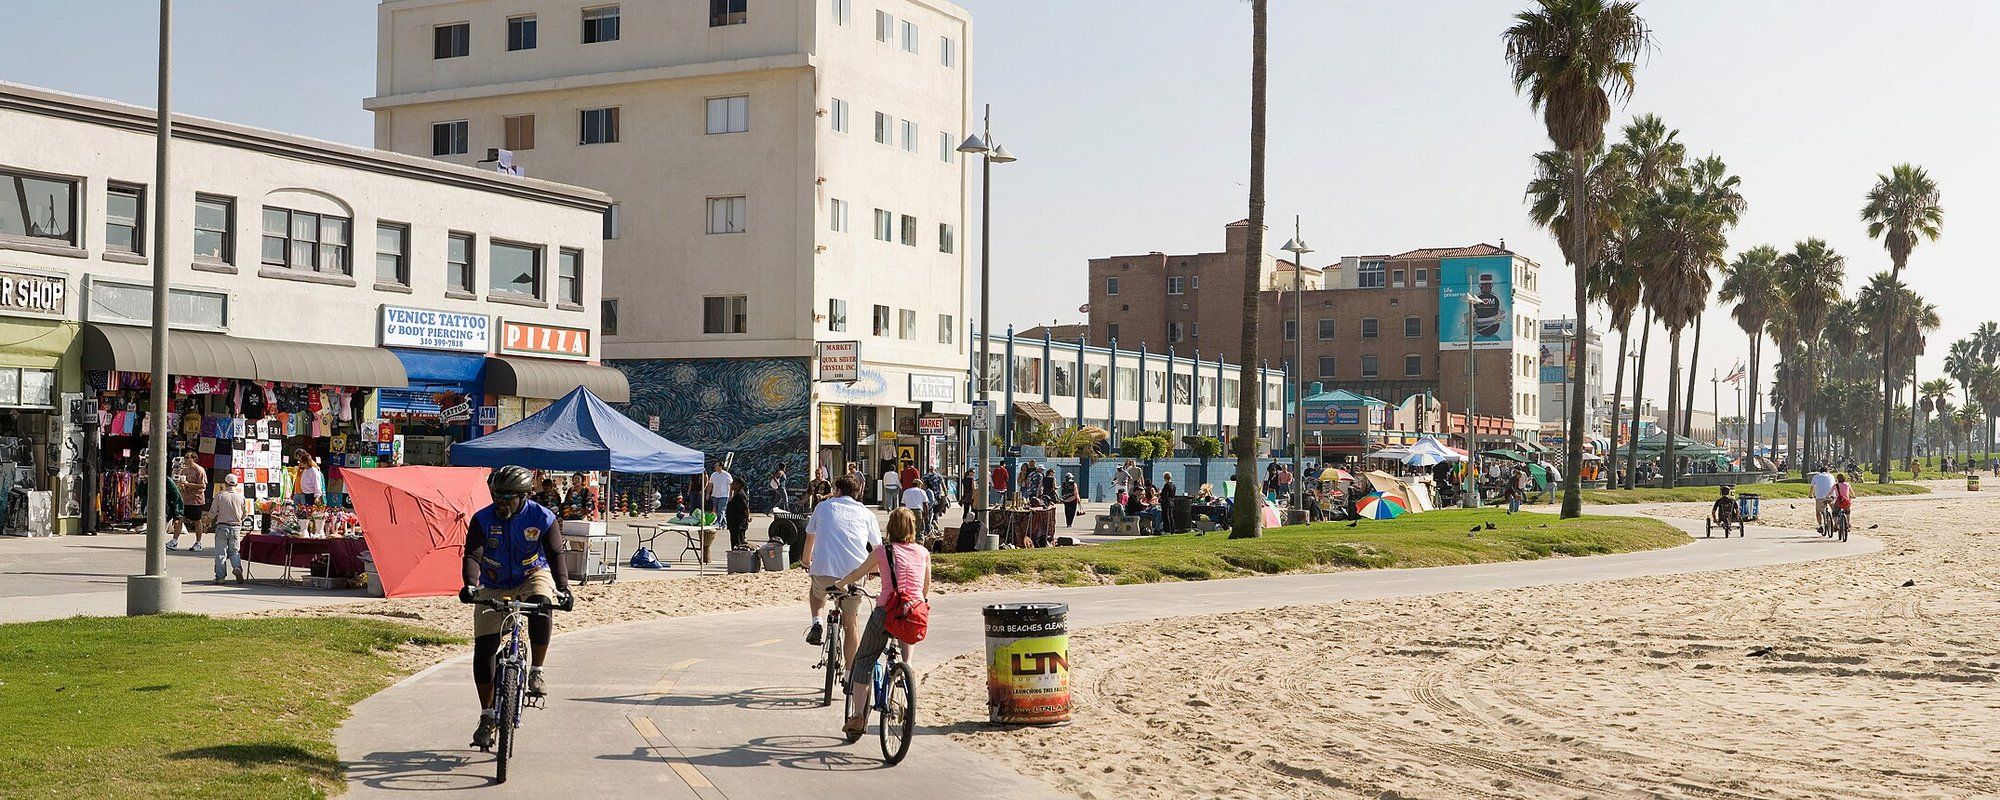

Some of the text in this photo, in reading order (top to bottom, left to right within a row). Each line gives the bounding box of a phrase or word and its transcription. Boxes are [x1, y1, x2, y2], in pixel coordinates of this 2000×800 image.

[16, 278, 64, 310] SHOP
[388, 309, 486, 329] VENICE TATTOO
[387, 324, 397, 334] &
[398, 325, 425, 336] BODY
[427, 328, 473, 340] PIERCING
[506, 324, 584, 353] PIZZA
[433, 339, 464, 347] 399-7818
[913, 383, 953, 398] MARKET
[442, 403, 468, 417] TATTOO
[480, 406, 496, 419] ATM
[920, 419, 943, 428] MARKET
[992, 624, 1005, 632] OUR
[1006, 623, 1042, 633] BEACHES
[1044, 621, 1064, 631] CLEAN
[1011, 650, 1069, 675] LTN
[1012, 687, 1043, 695] LAUNCHING
